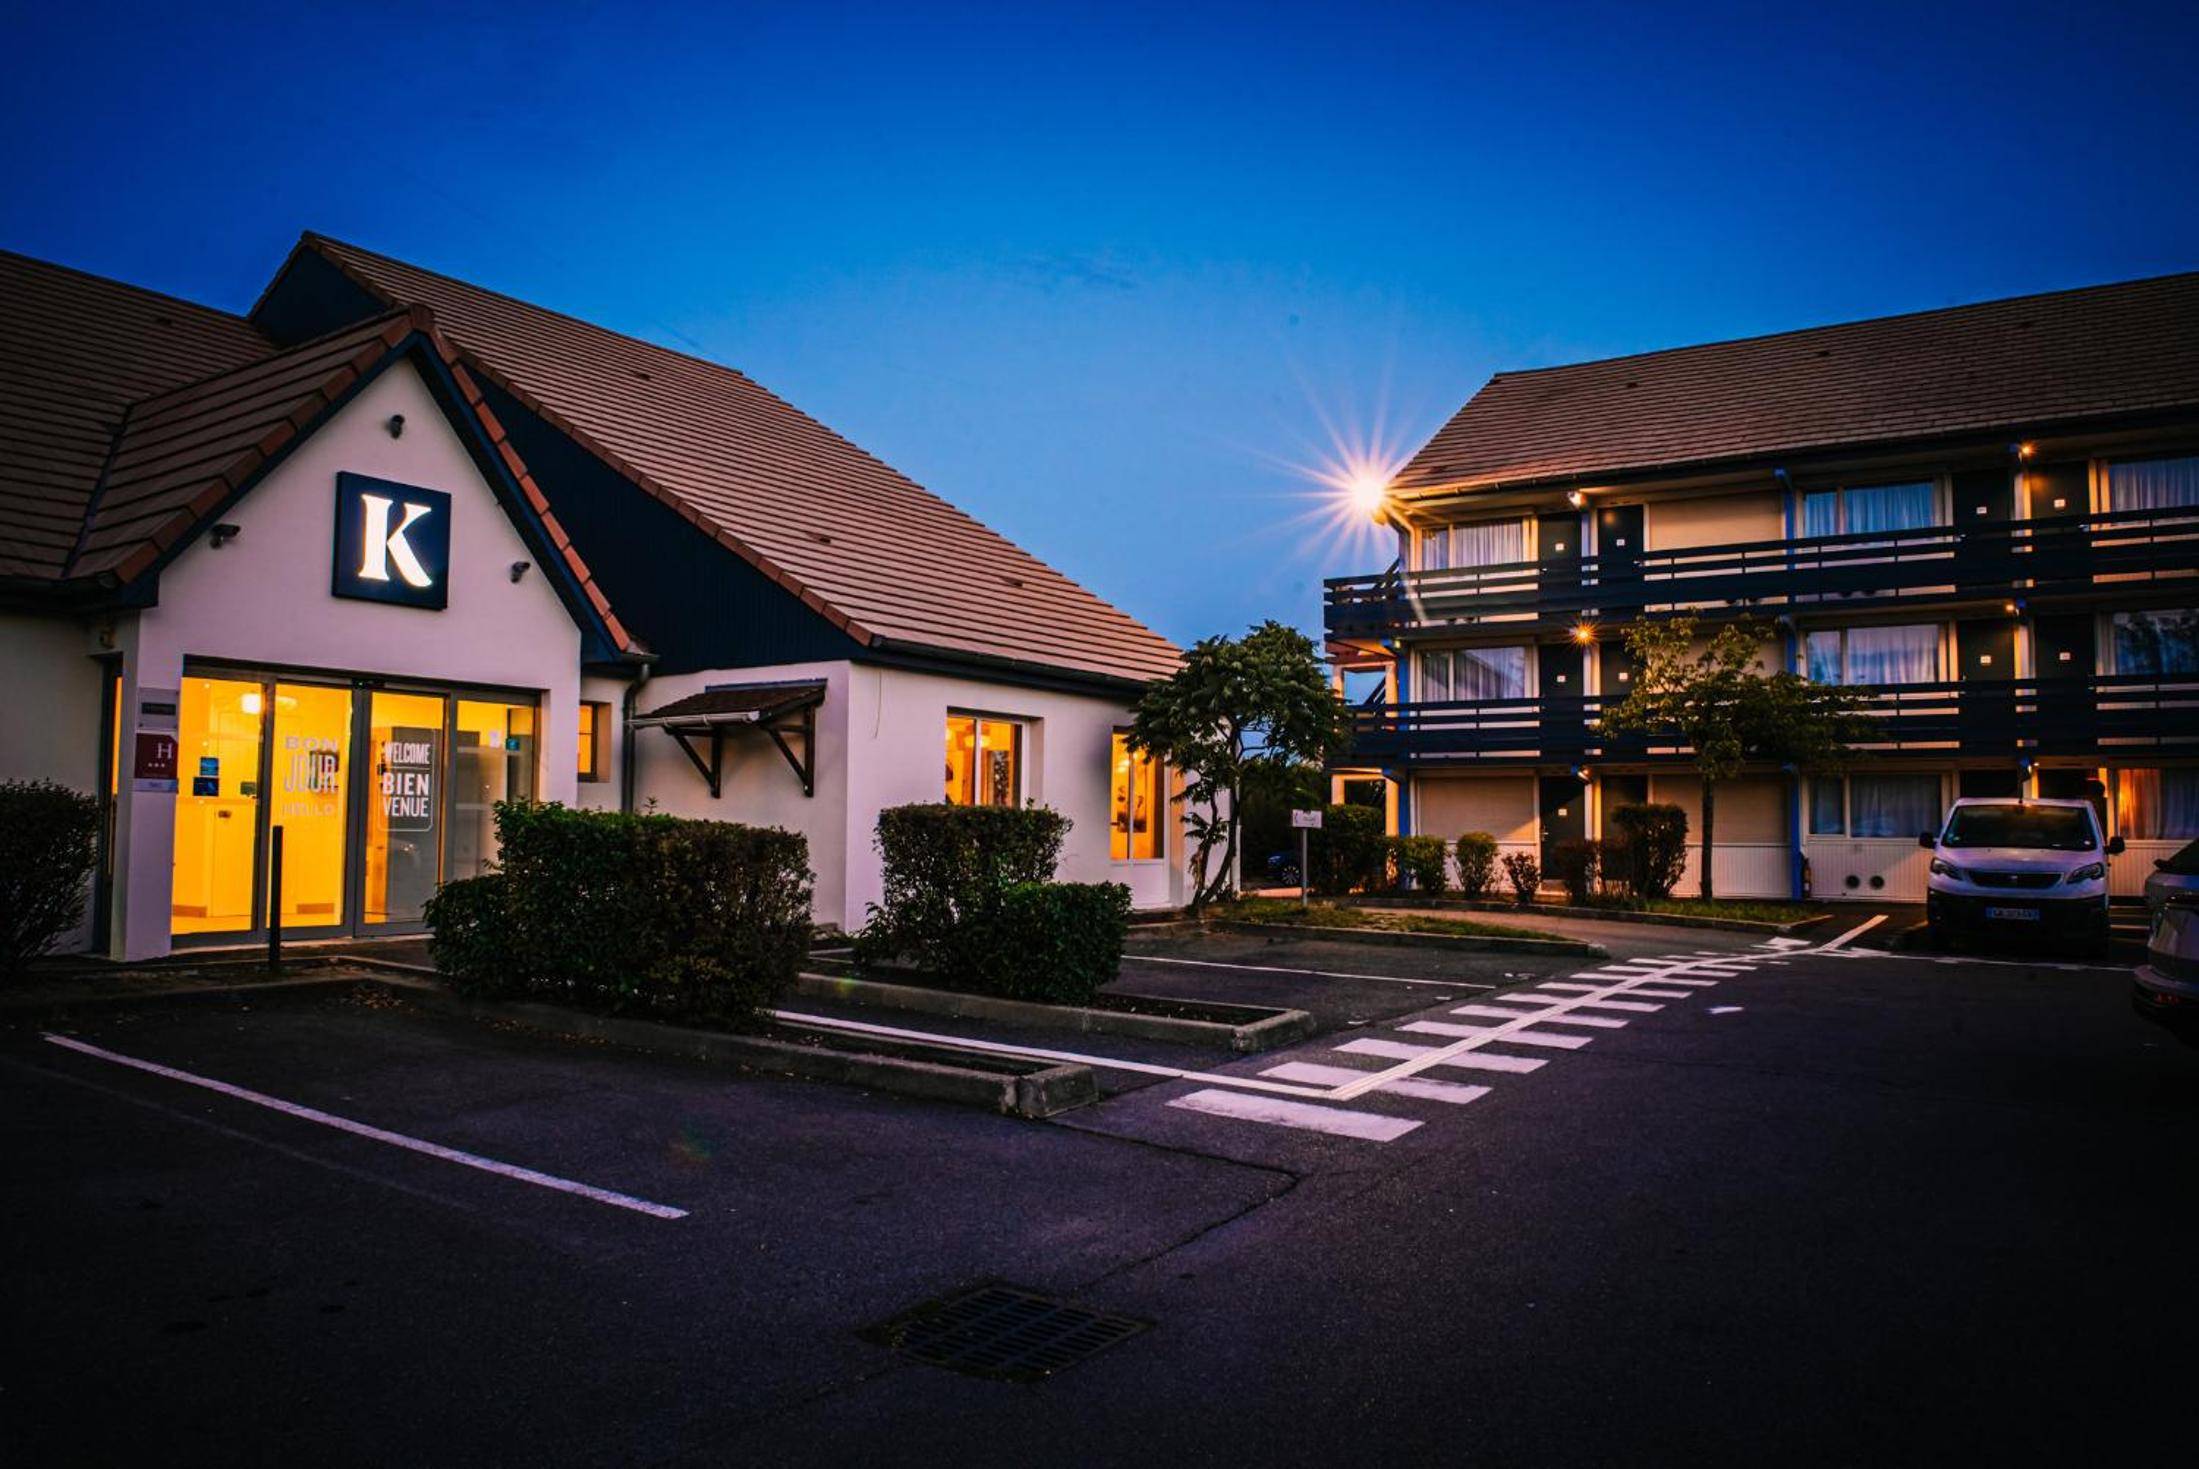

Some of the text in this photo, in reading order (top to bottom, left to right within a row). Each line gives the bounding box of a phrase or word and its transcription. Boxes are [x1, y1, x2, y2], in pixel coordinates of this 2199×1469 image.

[358, 493, 432, 587] K
[157, 742, 173, 759] H
[284, 735, 338, 751] BON
[384, 741, 430, 765] WELCOME
[283, 752, 336, 793] JOUR
[382, 771, 430, 796] BIEN
[383, 796, 429, 817] VENUE
